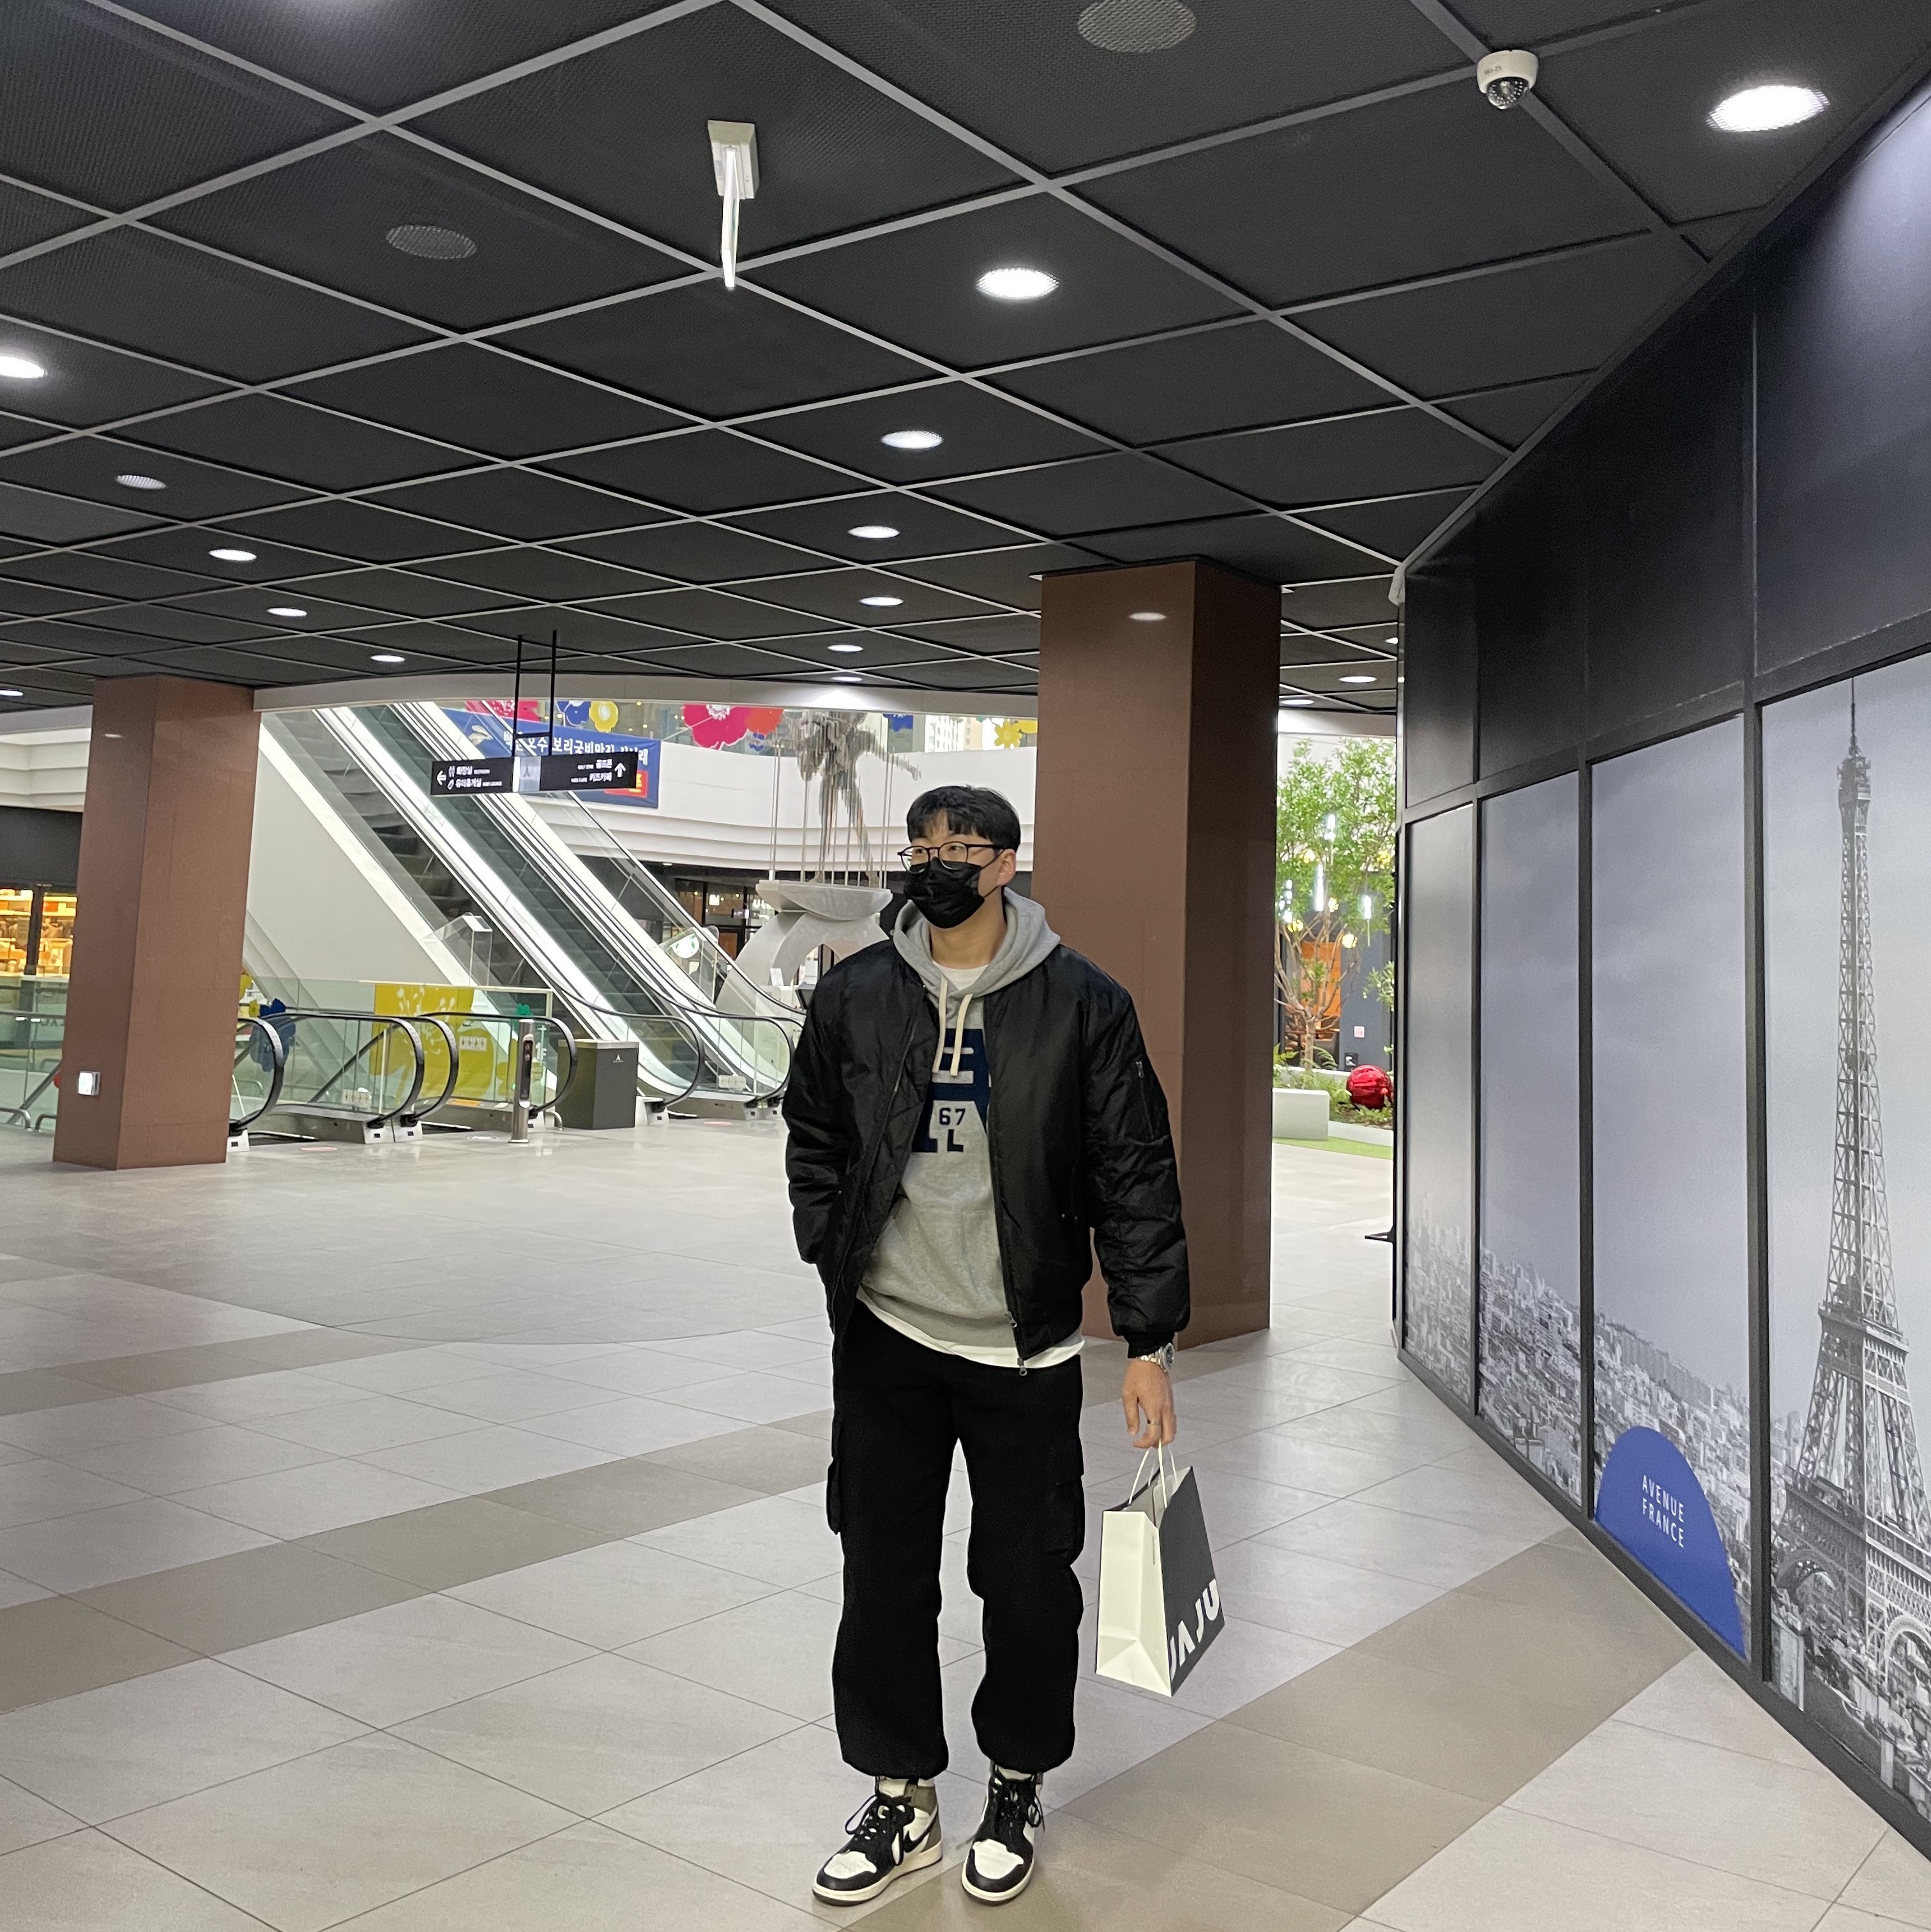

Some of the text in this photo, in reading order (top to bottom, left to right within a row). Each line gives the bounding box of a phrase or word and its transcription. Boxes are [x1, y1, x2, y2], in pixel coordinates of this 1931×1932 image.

[939, 1107, 966, 1126] 67
[1642, 1475, 1685, 1523] AVENUE
[1642, 1497, 1685, 1548] FRANCE
